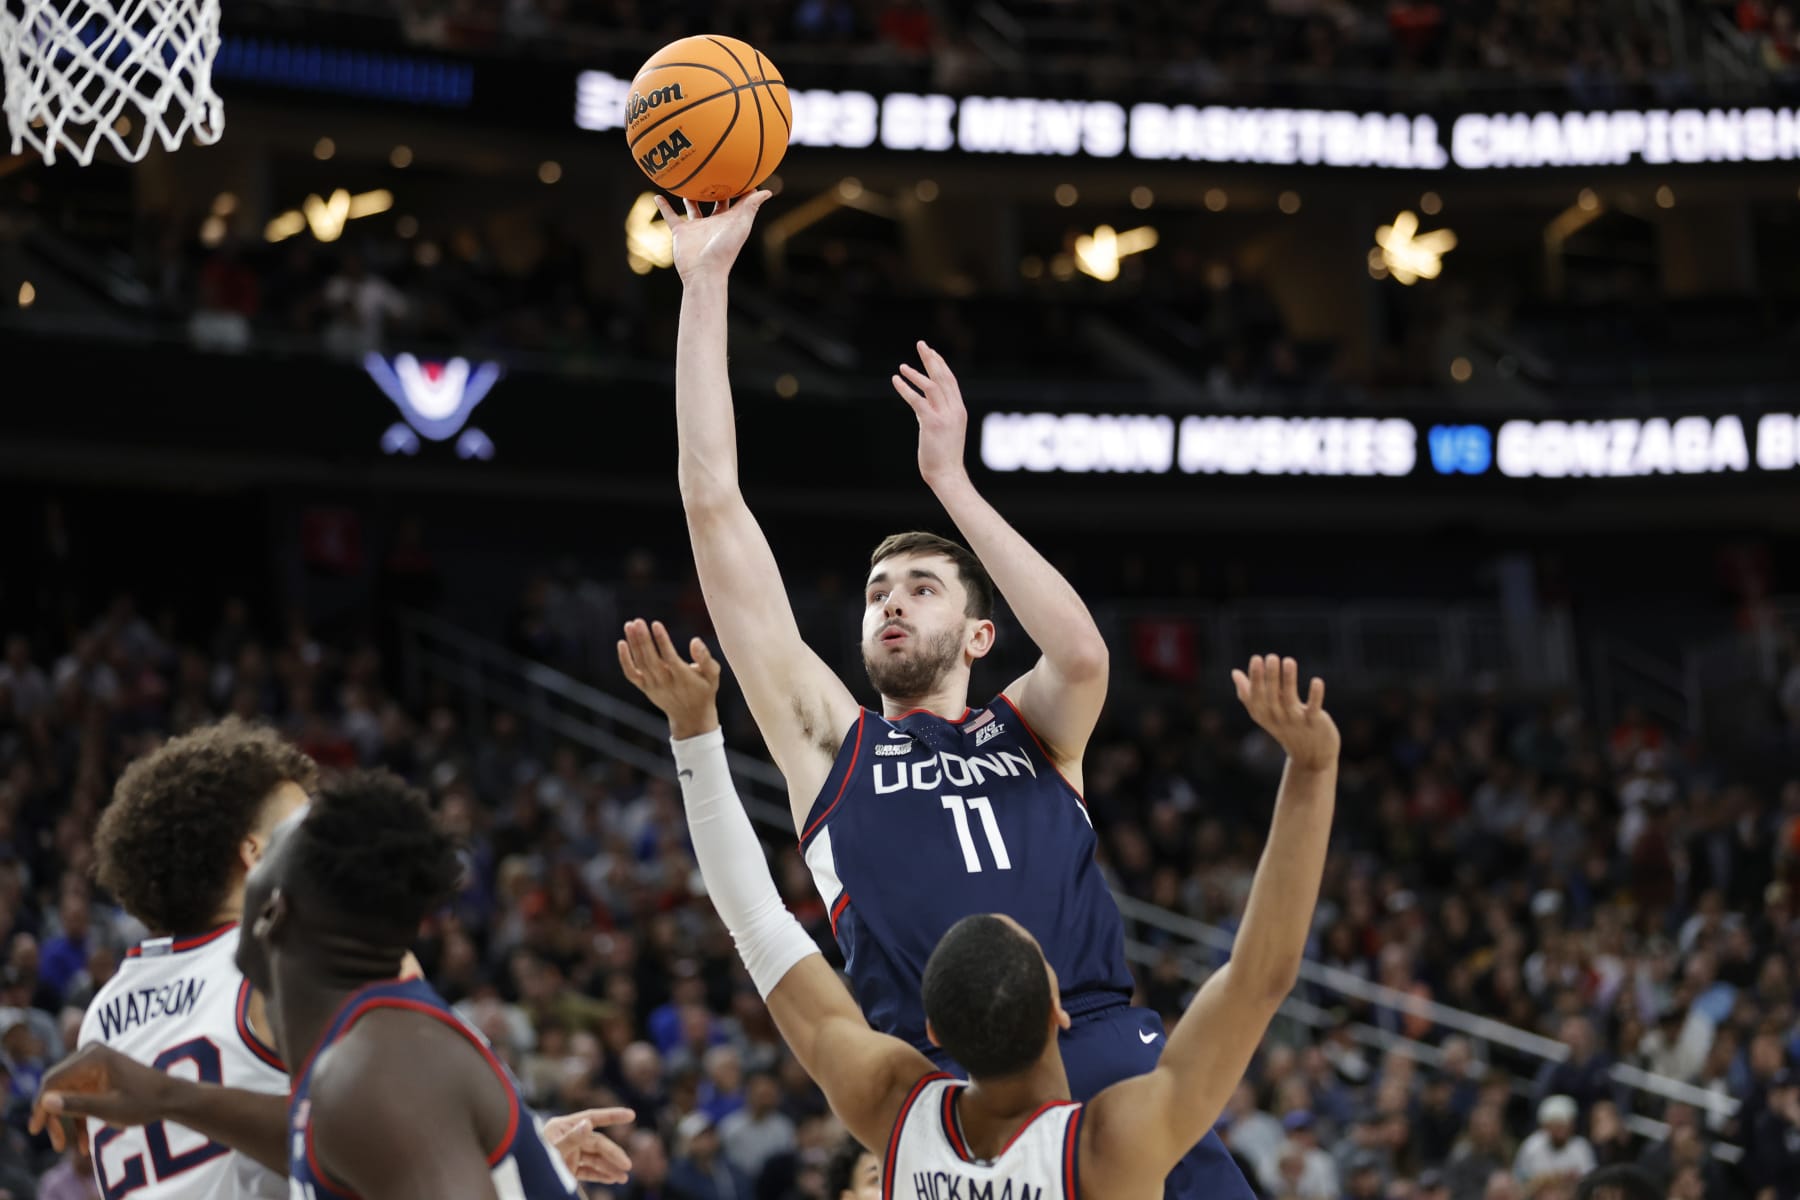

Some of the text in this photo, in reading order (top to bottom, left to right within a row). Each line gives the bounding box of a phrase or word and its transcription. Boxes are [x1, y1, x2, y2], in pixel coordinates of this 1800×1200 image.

[625, 82, 683, 132] ilson
[790, 90, 878, 147] 23
[1129, 104, 1448, 169] BASKETBALL
[638, 128, 693, 178] NCAA
[981, 413, 1800, 477] UCONN HUSKIES VS GONZAGA B
[872, 746, 1037, 795] UCONN
[940, 795, 1012, 873] 11
[98, 977, 206, 1041] WATSON
